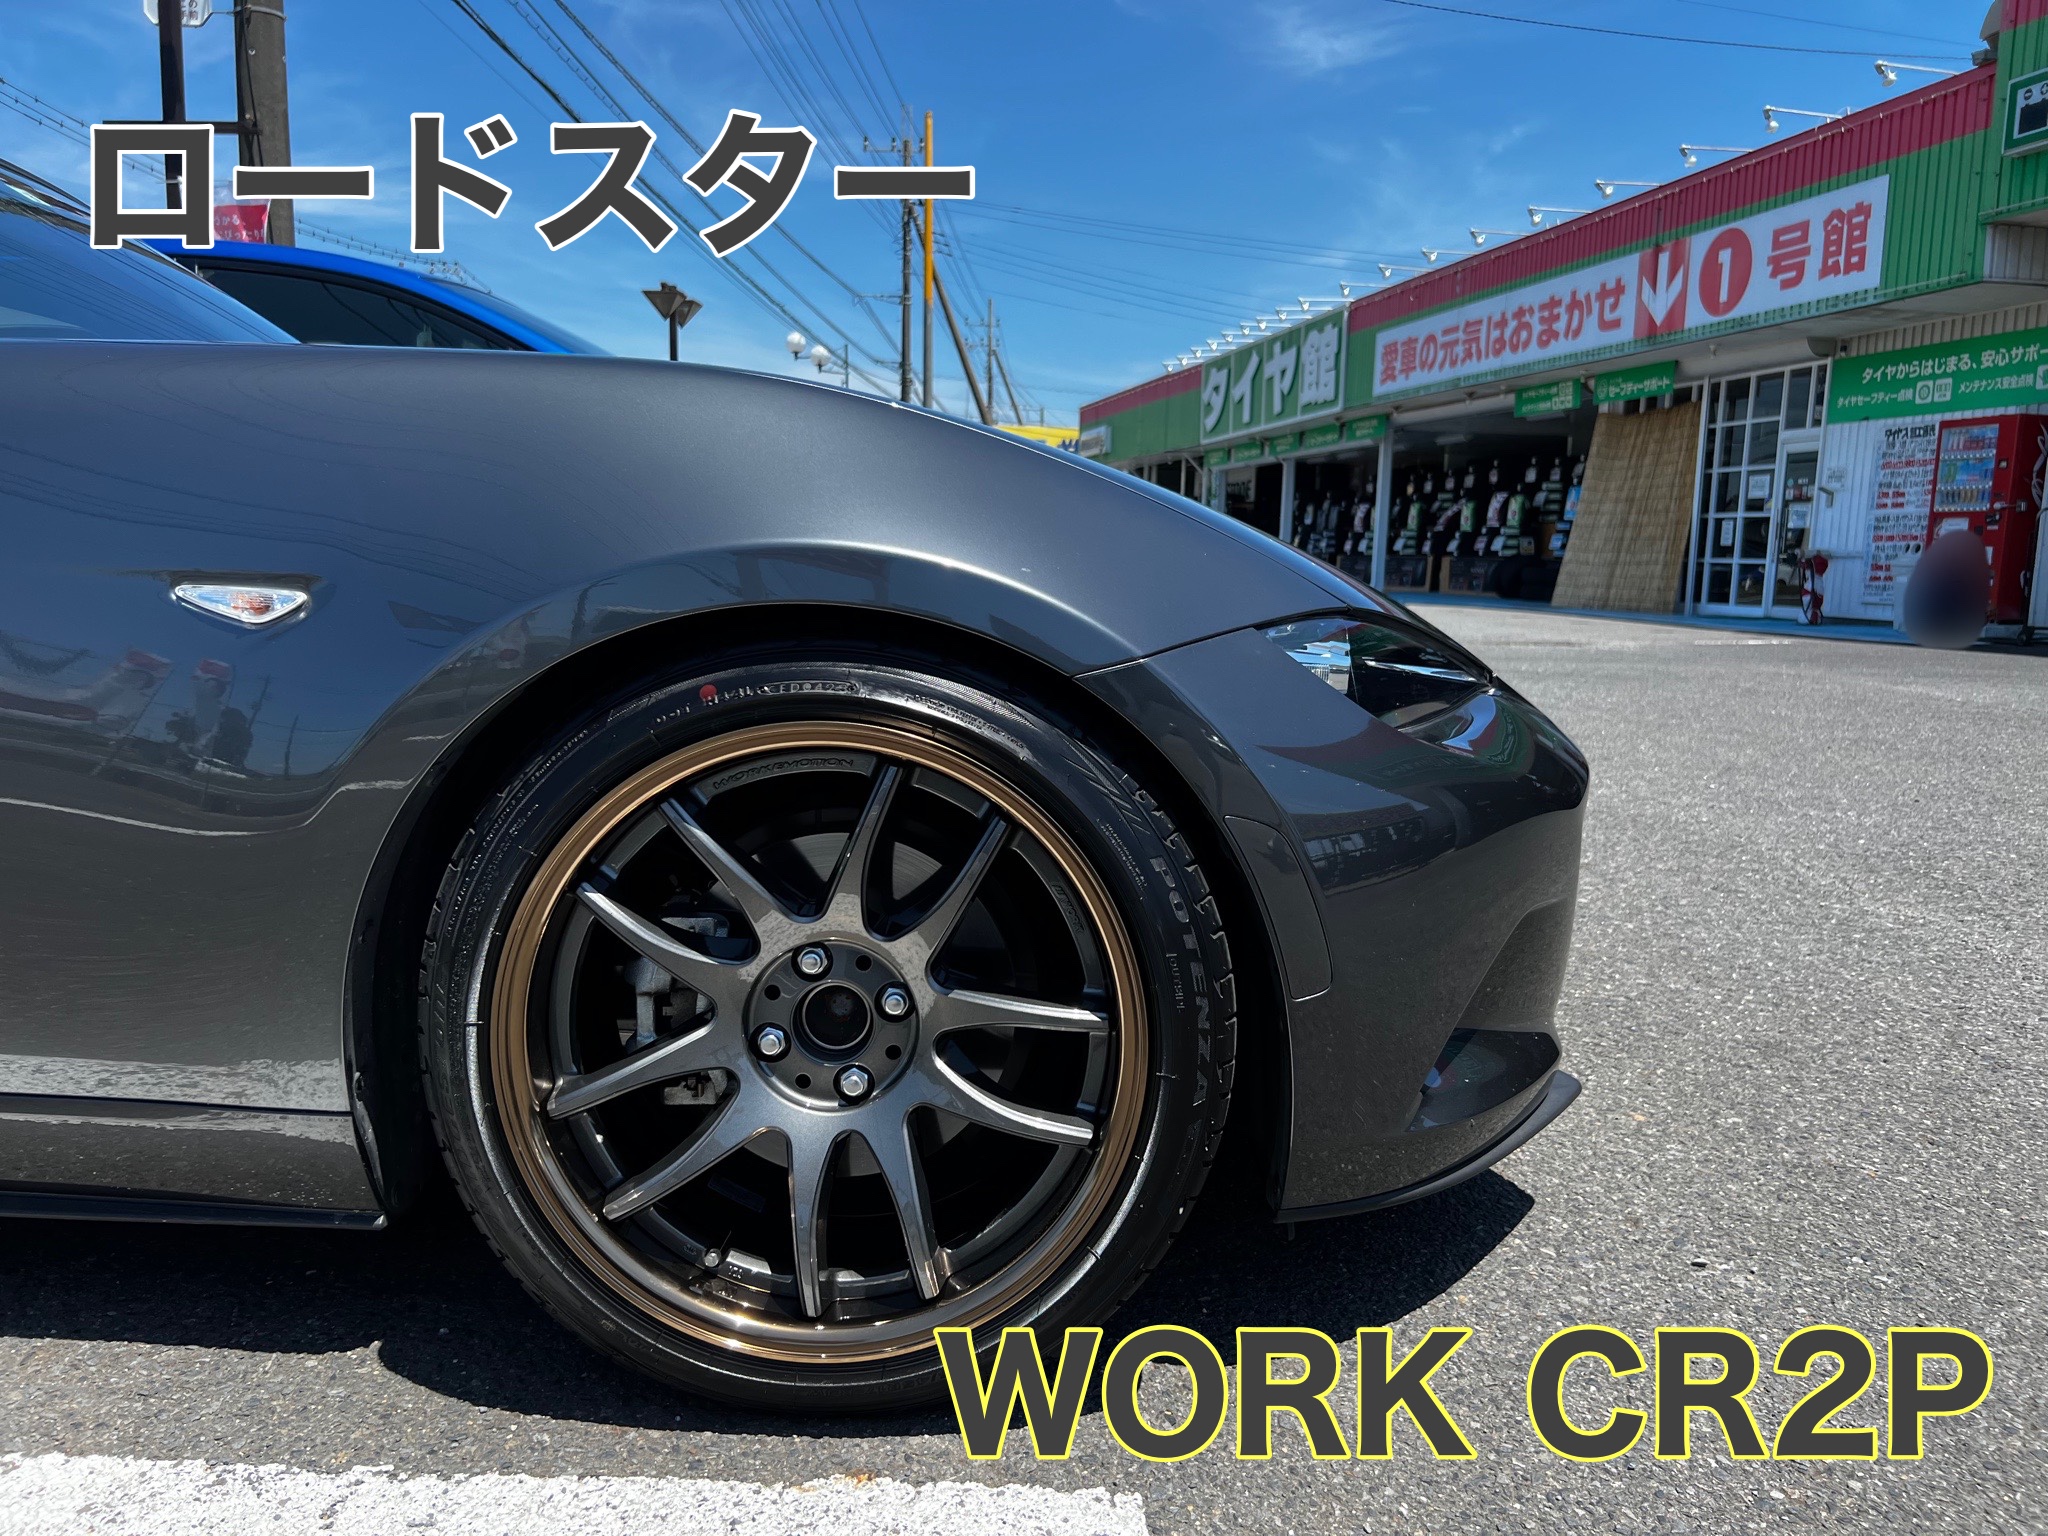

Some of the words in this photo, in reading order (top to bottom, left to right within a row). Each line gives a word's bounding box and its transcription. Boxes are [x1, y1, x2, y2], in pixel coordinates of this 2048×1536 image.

[1202, 323, 1337, 432] タイヤ館
[1380, 277, 1625, 385] 愛車の元気はおまかせ
[1150, 855, 1211, 1106] POTENZA
